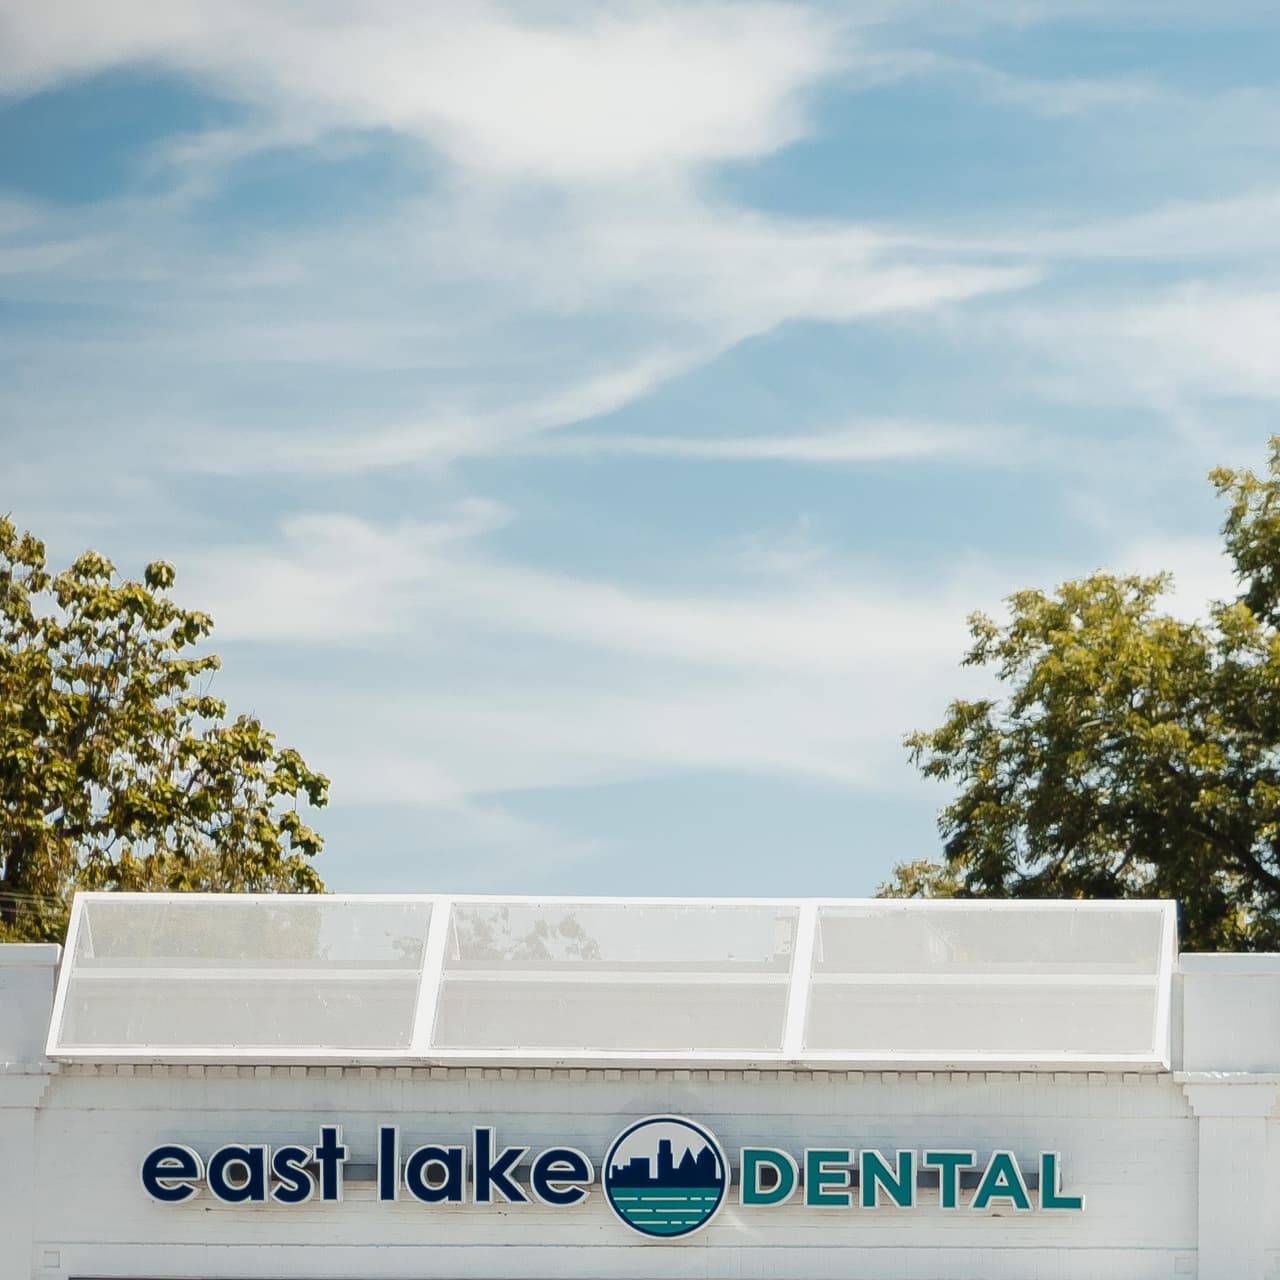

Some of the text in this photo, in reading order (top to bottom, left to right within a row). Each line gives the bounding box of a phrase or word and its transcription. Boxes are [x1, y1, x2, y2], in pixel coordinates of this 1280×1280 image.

[139, 1124, 1086, 1212] east lake DENTAL
